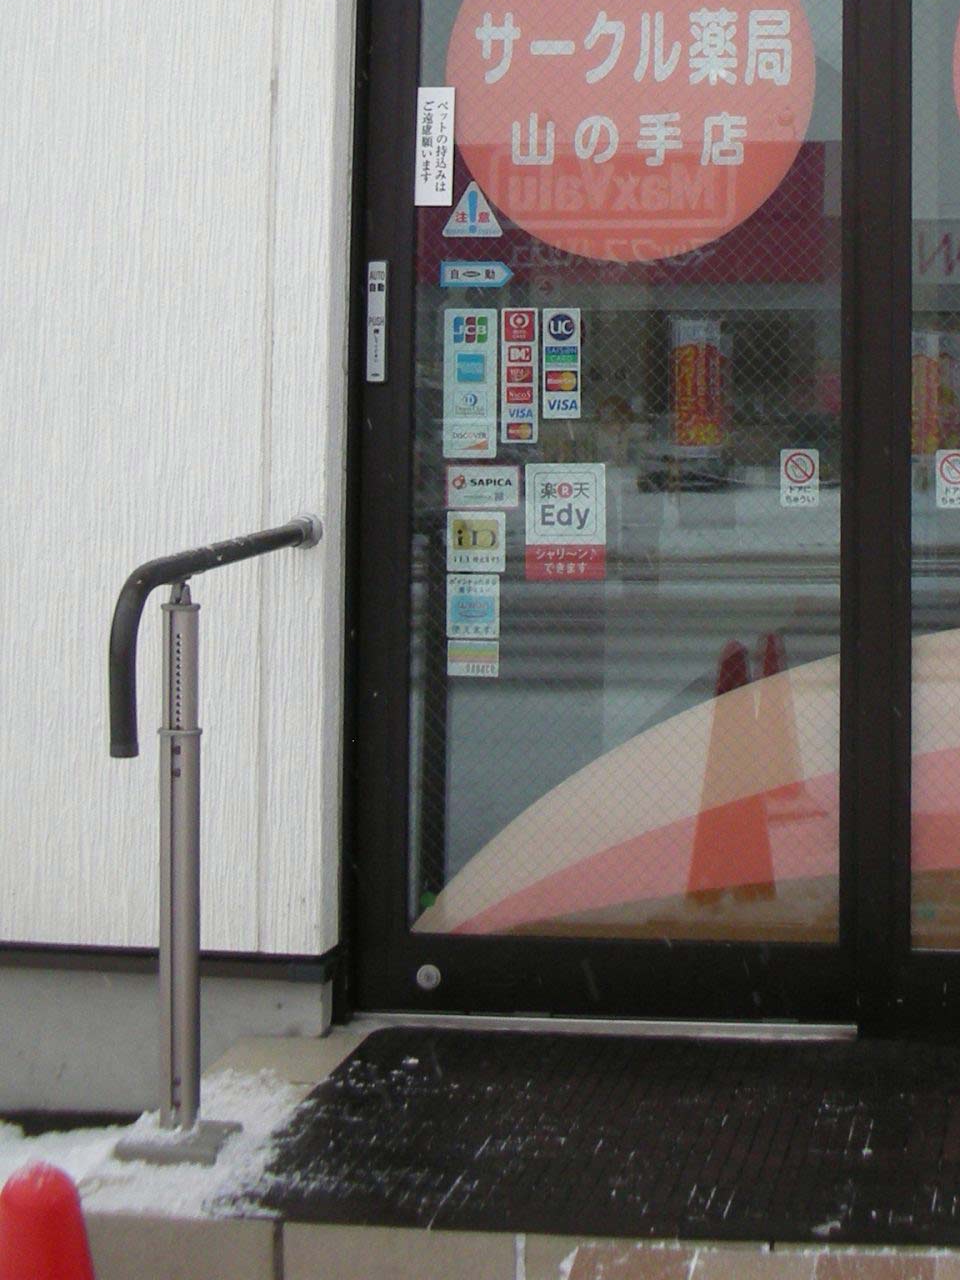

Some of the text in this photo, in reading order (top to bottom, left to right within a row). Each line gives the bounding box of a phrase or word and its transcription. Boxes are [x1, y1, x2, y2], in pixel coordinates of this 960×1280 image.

[475, 8, 792, 86] サークル薬局
[420, 101, 435, 183] ご遠慮願います
[435, 101, 449, 192] ペットの持込みは
[511, 112, 747, 167] 山の手店
[550, 319, 574, 335] UC
[508, 408, 533, 419] VISA
[547, 399, 578, 412] VISA
[470, 478, 512, 487] SAPICA
[541, 503, 590, 530] Edy
[544, 562, 587, 574] できます
